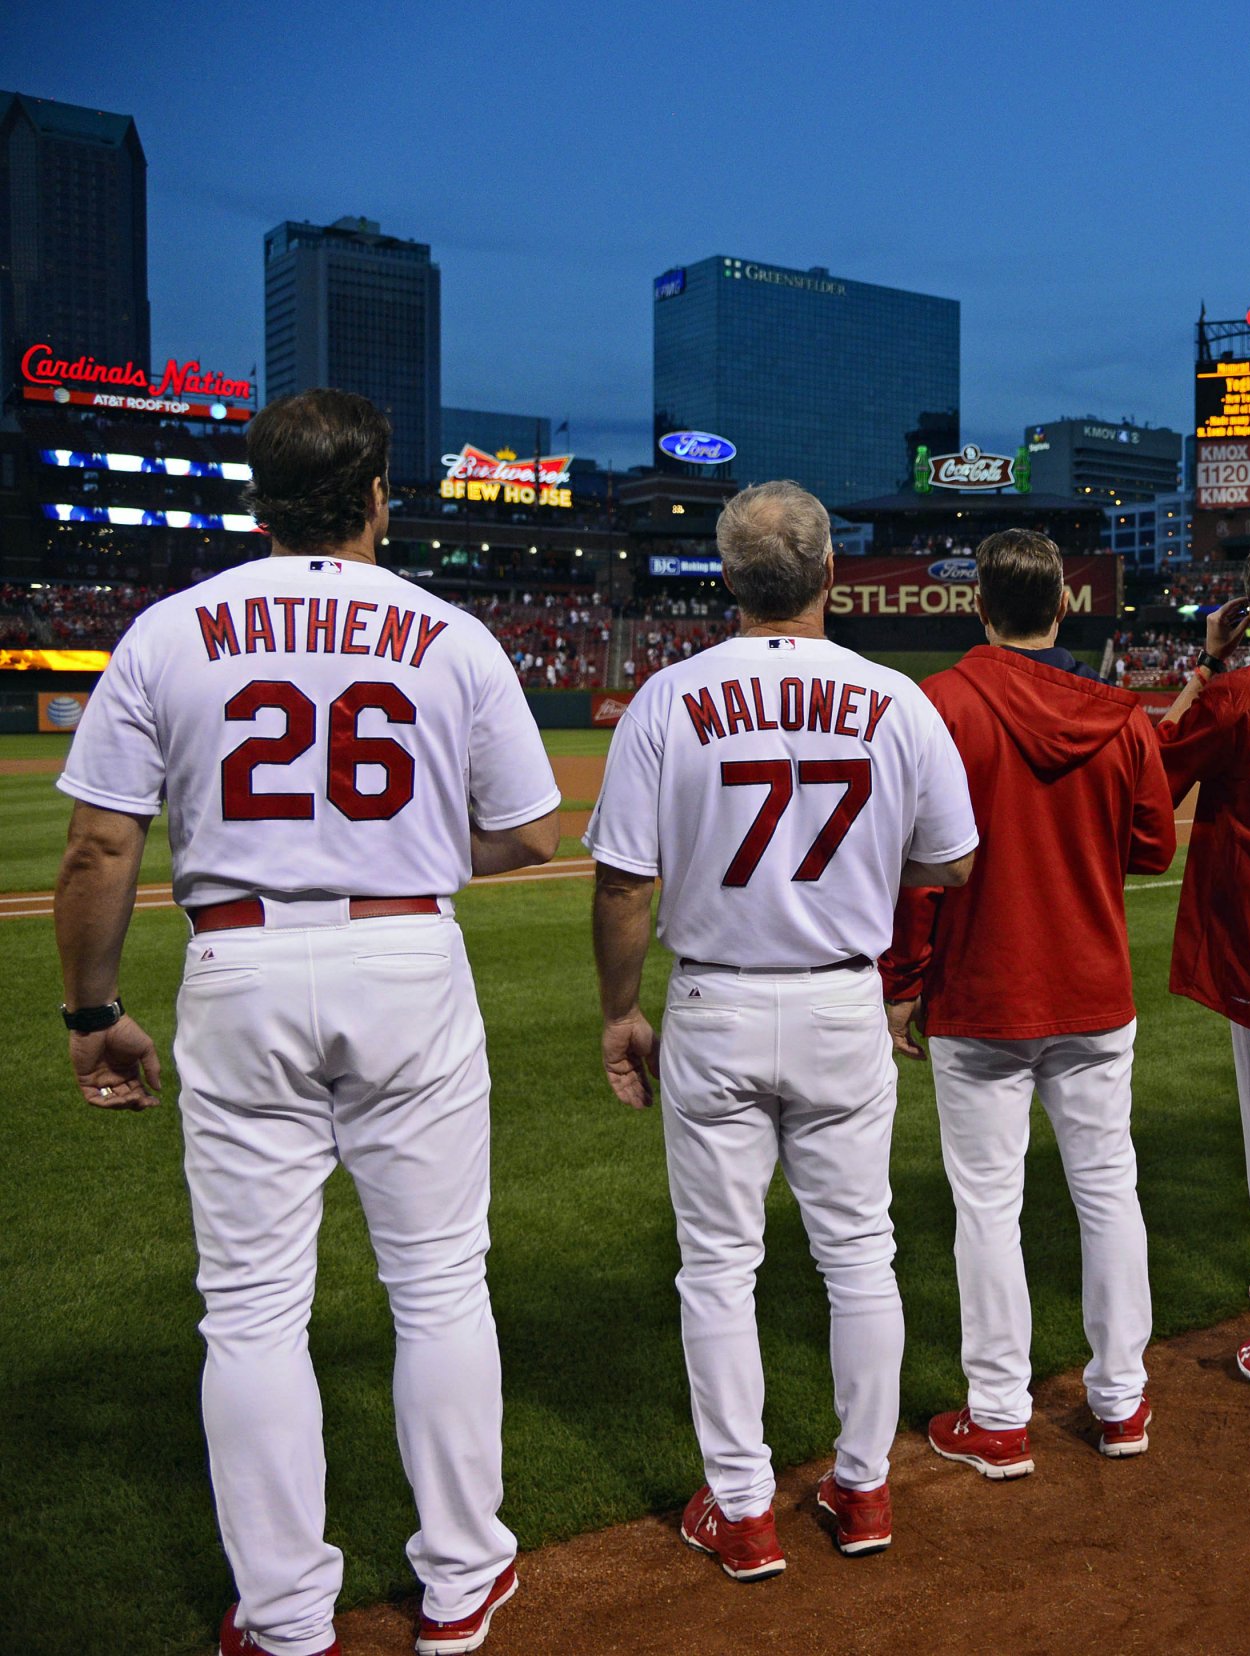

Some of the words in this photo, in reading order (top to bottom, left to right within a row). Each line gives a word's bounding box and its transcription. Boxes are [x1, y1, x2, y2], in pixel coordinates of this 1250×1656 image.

[21, 343, 148, 387] Cardinals
[148, 358, 250, 399] Nation
[93, 393, 124, 407] AT&T
[126, 396, 191, 414] ROOFTOP
[1083, 426, 1117, 440] KMOV
[675, 435, 722, 460] Ford
[1201, 444, 1249, 461] KMOX
[441, 453, 570, 484] Budweiser
[939, 457, 1005, 483] Coca-Cola
[1201, 464, 1249, 484] 1120
[441, 480, 501, 502] BREW
[504, 486, 572, 508] HOUSE
[1201, 486, 1249, 504] KMOX
[195, 596, 449, 669] MATHENY
[682, 677, 893, 746] MALONEY
[221, 679, 417, 822] 26
[720, 758, 872, 888] 77
